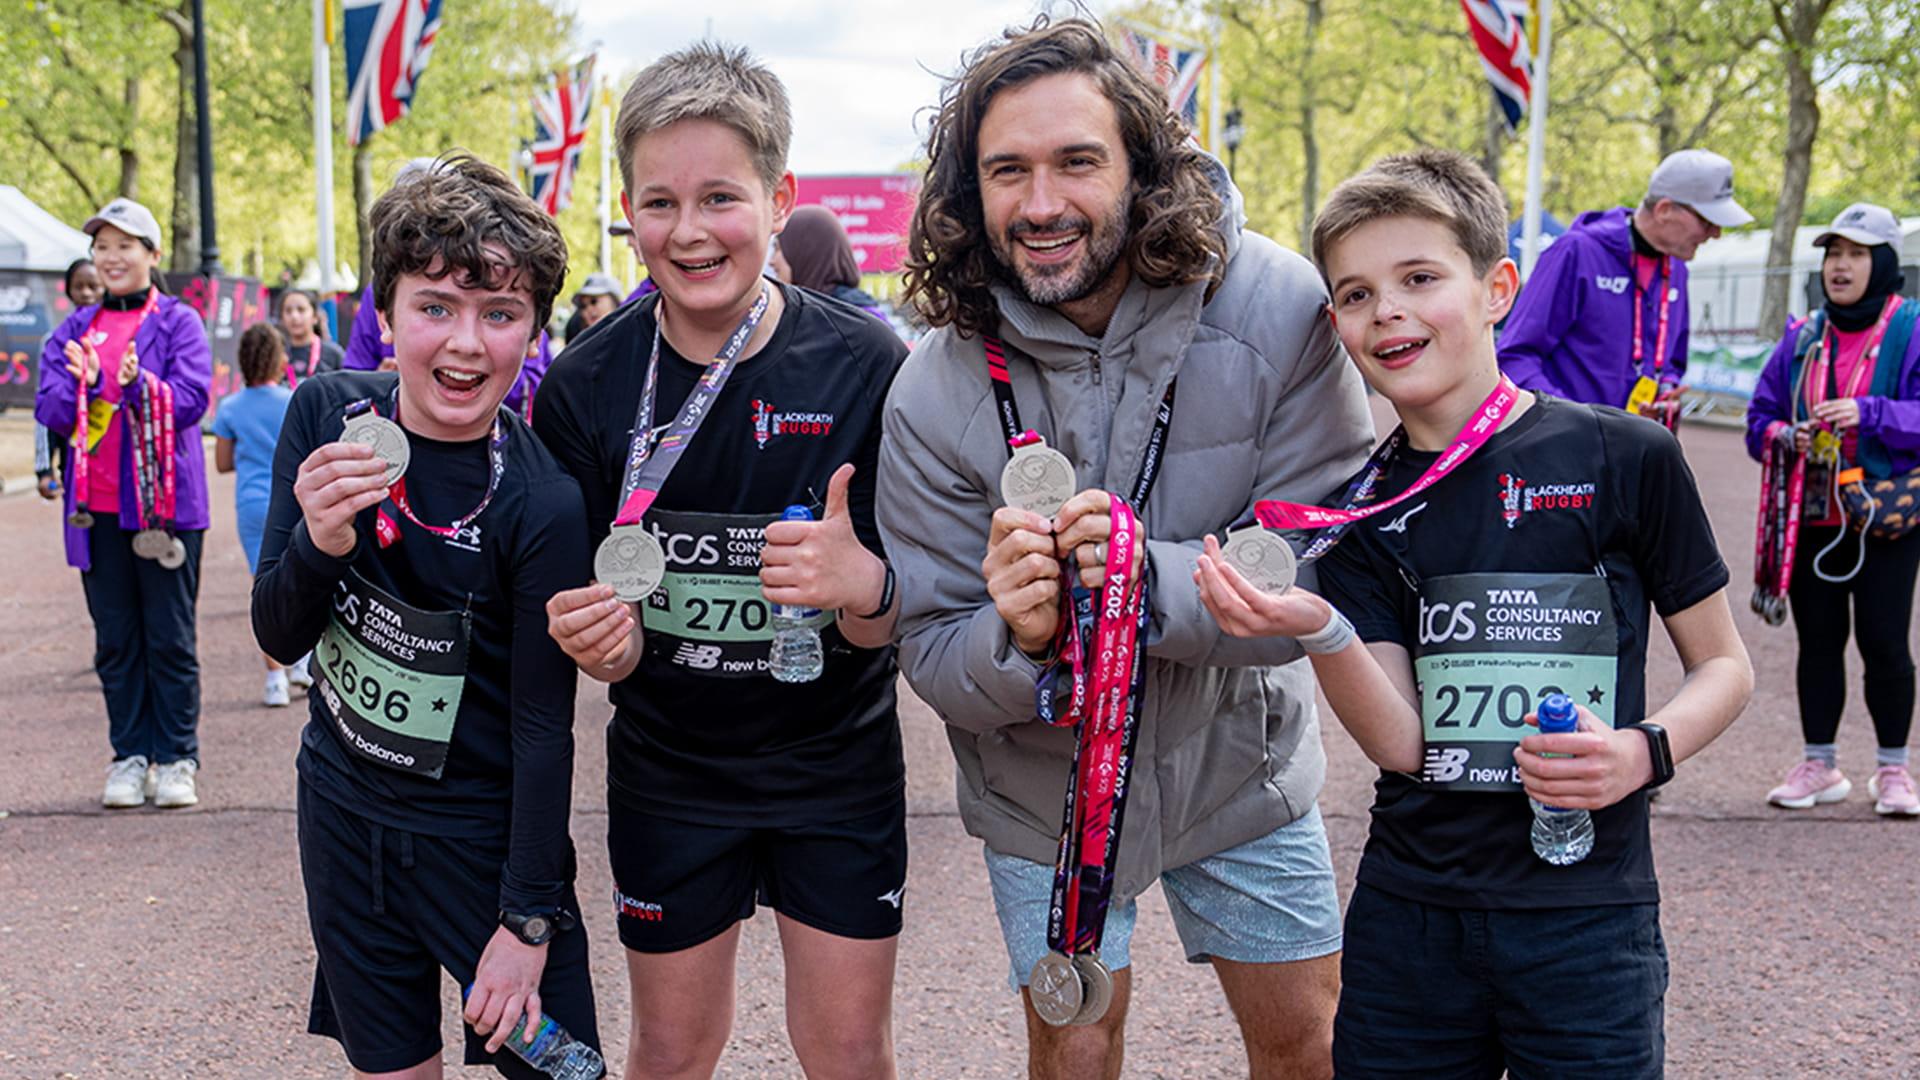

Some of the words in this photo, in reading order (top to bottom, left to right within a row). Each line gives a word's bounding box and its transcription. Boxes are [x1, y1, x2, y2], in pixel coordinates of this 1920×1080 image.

[773, 412, 834, 424] BLACKHEATH
[779, 421, 833, 435] RUGBY
[1524, 483, 1595, 497] BLACKHEATH
[1532, 494, 1594, 510] RUGBY
[728, 556, 763, 567] SERV
[651, 593, 666, 607] 10
[1106, 573, 1125, 619] 2024
[1486, 589, 1538, 605] TATA
[368, 598, 403, 629] TATA
[685, 597, 768, 633] 270
[1485, 607, 1602, 625] CONSULTANCY
[363, 612, 455, 654] CONSULTANCY
[1485, 626, 1563, 642] SERVICES
[361, 626, 416, 662] SERVICES
[723, 660, 756, 672] new
[327, 643, 411, 723] 2696
[1108, 686, 1121, 731] FINISHER
[356, 733, 415, 767] balance
[1470, 767, 1508, 782] new
